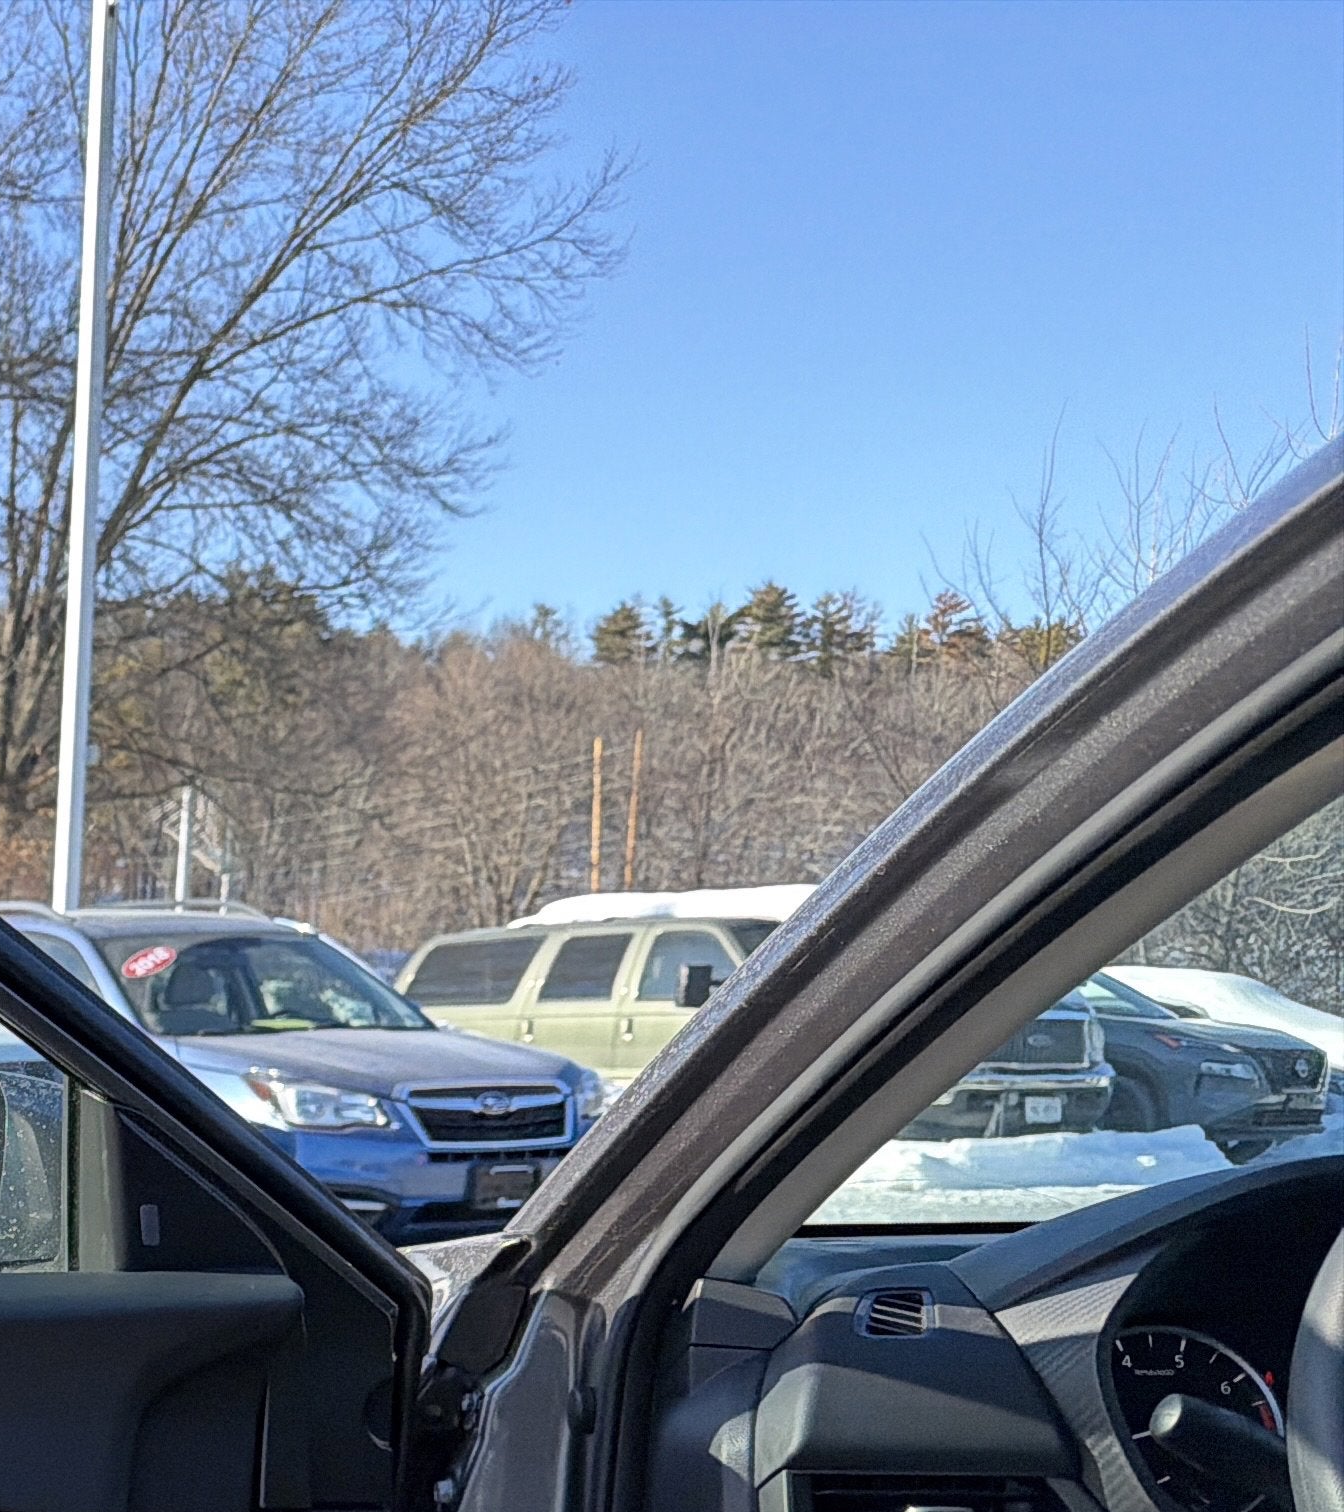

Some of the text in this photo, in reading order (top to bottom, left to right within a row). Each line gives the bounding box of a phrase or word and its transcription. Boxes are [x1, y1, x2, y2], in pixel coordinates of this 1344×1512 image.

[1121, 1355, 1133, 1368] 4
[1174, 1355, 1185, 1369] 5
[1220, 1381, 1231, 1395] 6
